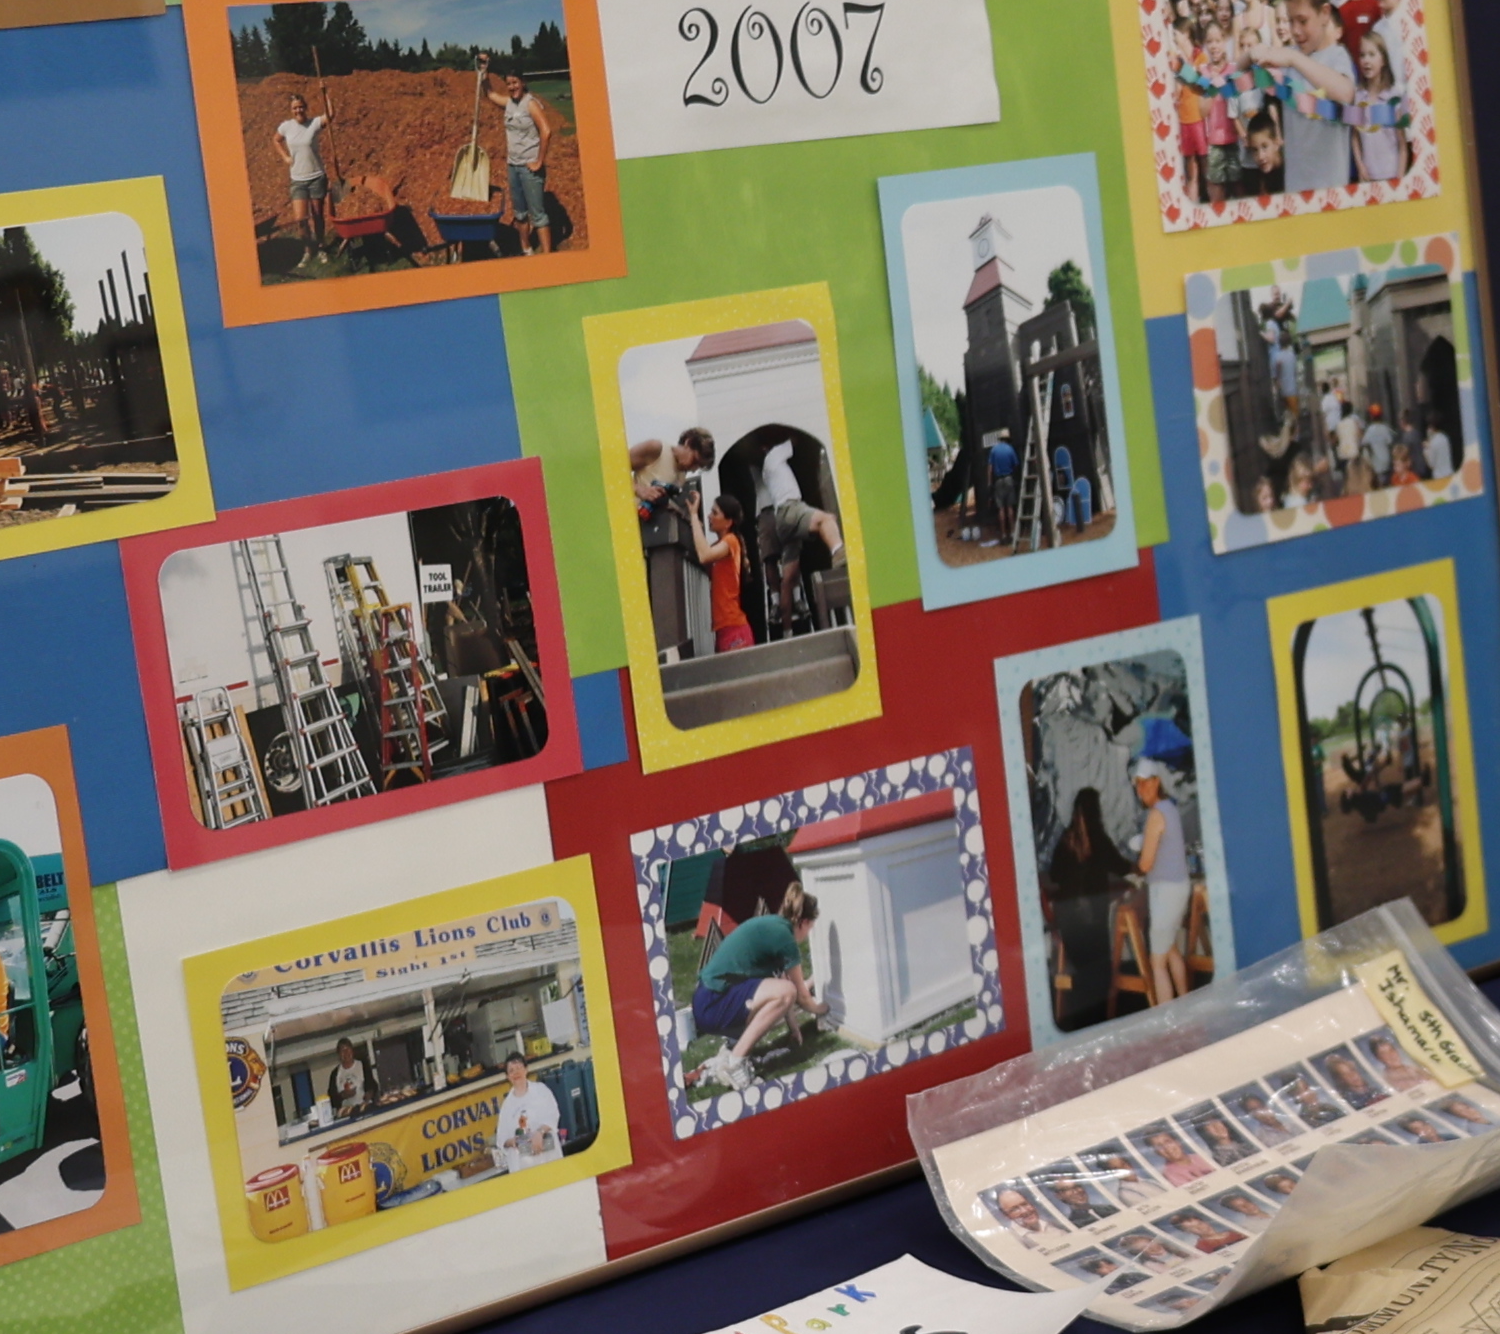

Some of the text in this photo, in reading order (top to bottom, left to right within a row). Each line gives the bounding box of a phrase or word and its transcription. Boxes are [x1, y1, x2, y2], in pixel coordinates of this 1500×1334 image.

[678, 1, 886, 107] 2007
[423, 583, 452, 593] TRAILER
[429, 572, 447, 581] TOOL
[414, 925, 476, 949] Lions
[486, 911, 531, 933] Club
[421, 1097, 501, 1140] CORVAL
[420, 1133, 486, 1173] LIONS
